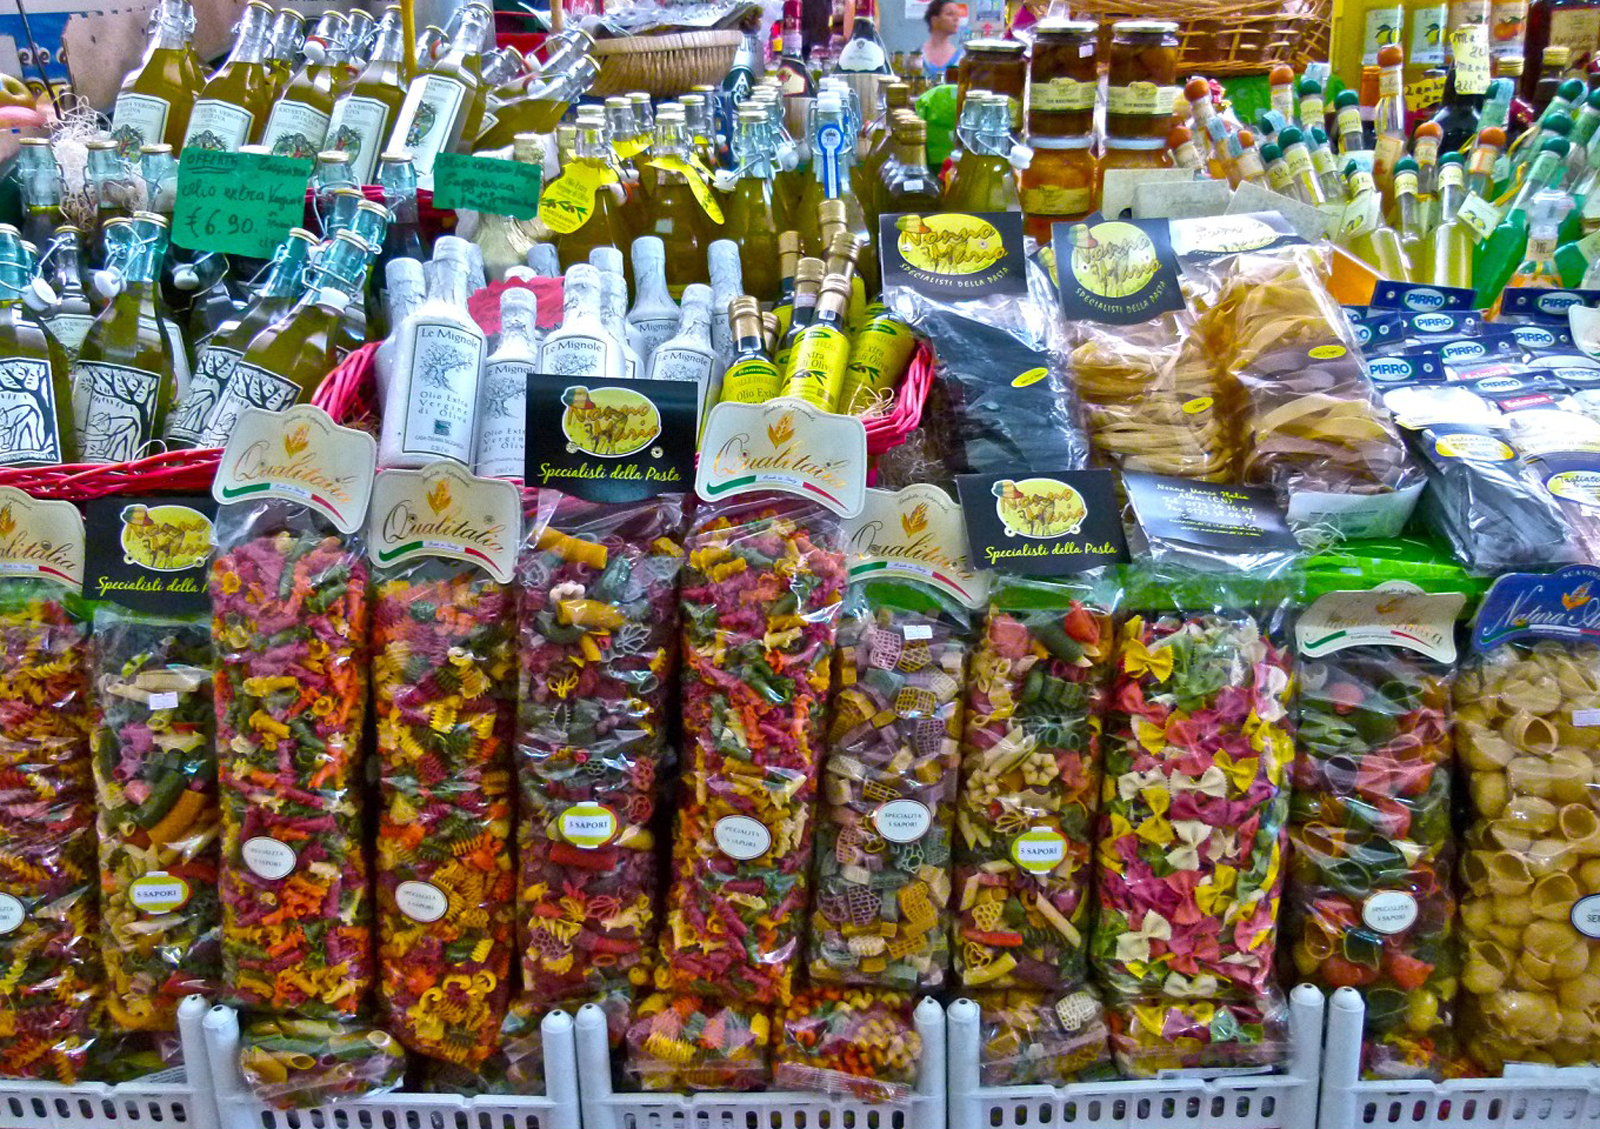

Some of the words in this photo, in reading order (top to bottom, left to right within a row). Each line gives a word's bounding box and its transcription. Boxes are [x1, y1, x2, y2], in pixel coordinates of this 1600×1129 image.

[1407, 294, 1443, 306] PIRRO
[1541, 297, 1583, 309] PIRRO
[1417, 317, 1451, 328] PIRRO
[421, 328, 434, 339] Le
[438, 328, 479, 350] Mignole
[1516, 332, 1553, 344] PIRRO
[558, 338, 602, 352] Mignole
[1446, 345, 1483, 356] PIRRO
[669, 351, 709, 366] Mignole
[495, 364, 535, 375] Mignol
[1369, 362, 1409, 374] PIRRO
[1481, 380, 1519, 389] PIRRO
[420, 391, 442, 400] Olio
[737, 390, 754, 402] Olio
[418, 406, 429, 415] di
[419, 399, 468, 416] Vergine
[537, 463, 606, 484] Specialisti
[610, 463, 643, 480] della
[646, 465, 682, 482] Pasta
[985, 543, 1049, 565] Specialisti
[1052, 541, 1082, 556] della
[1085, 541, 1118, 555] Pasta
[96, 576, 164, 597] Specialisti
[167, 576, 199, 593] della
[575, 820, 608, 830] SAPORI
[1026, 847, 1057, 855] SAPORI
[143, 889, 178, 898] SAPORI
